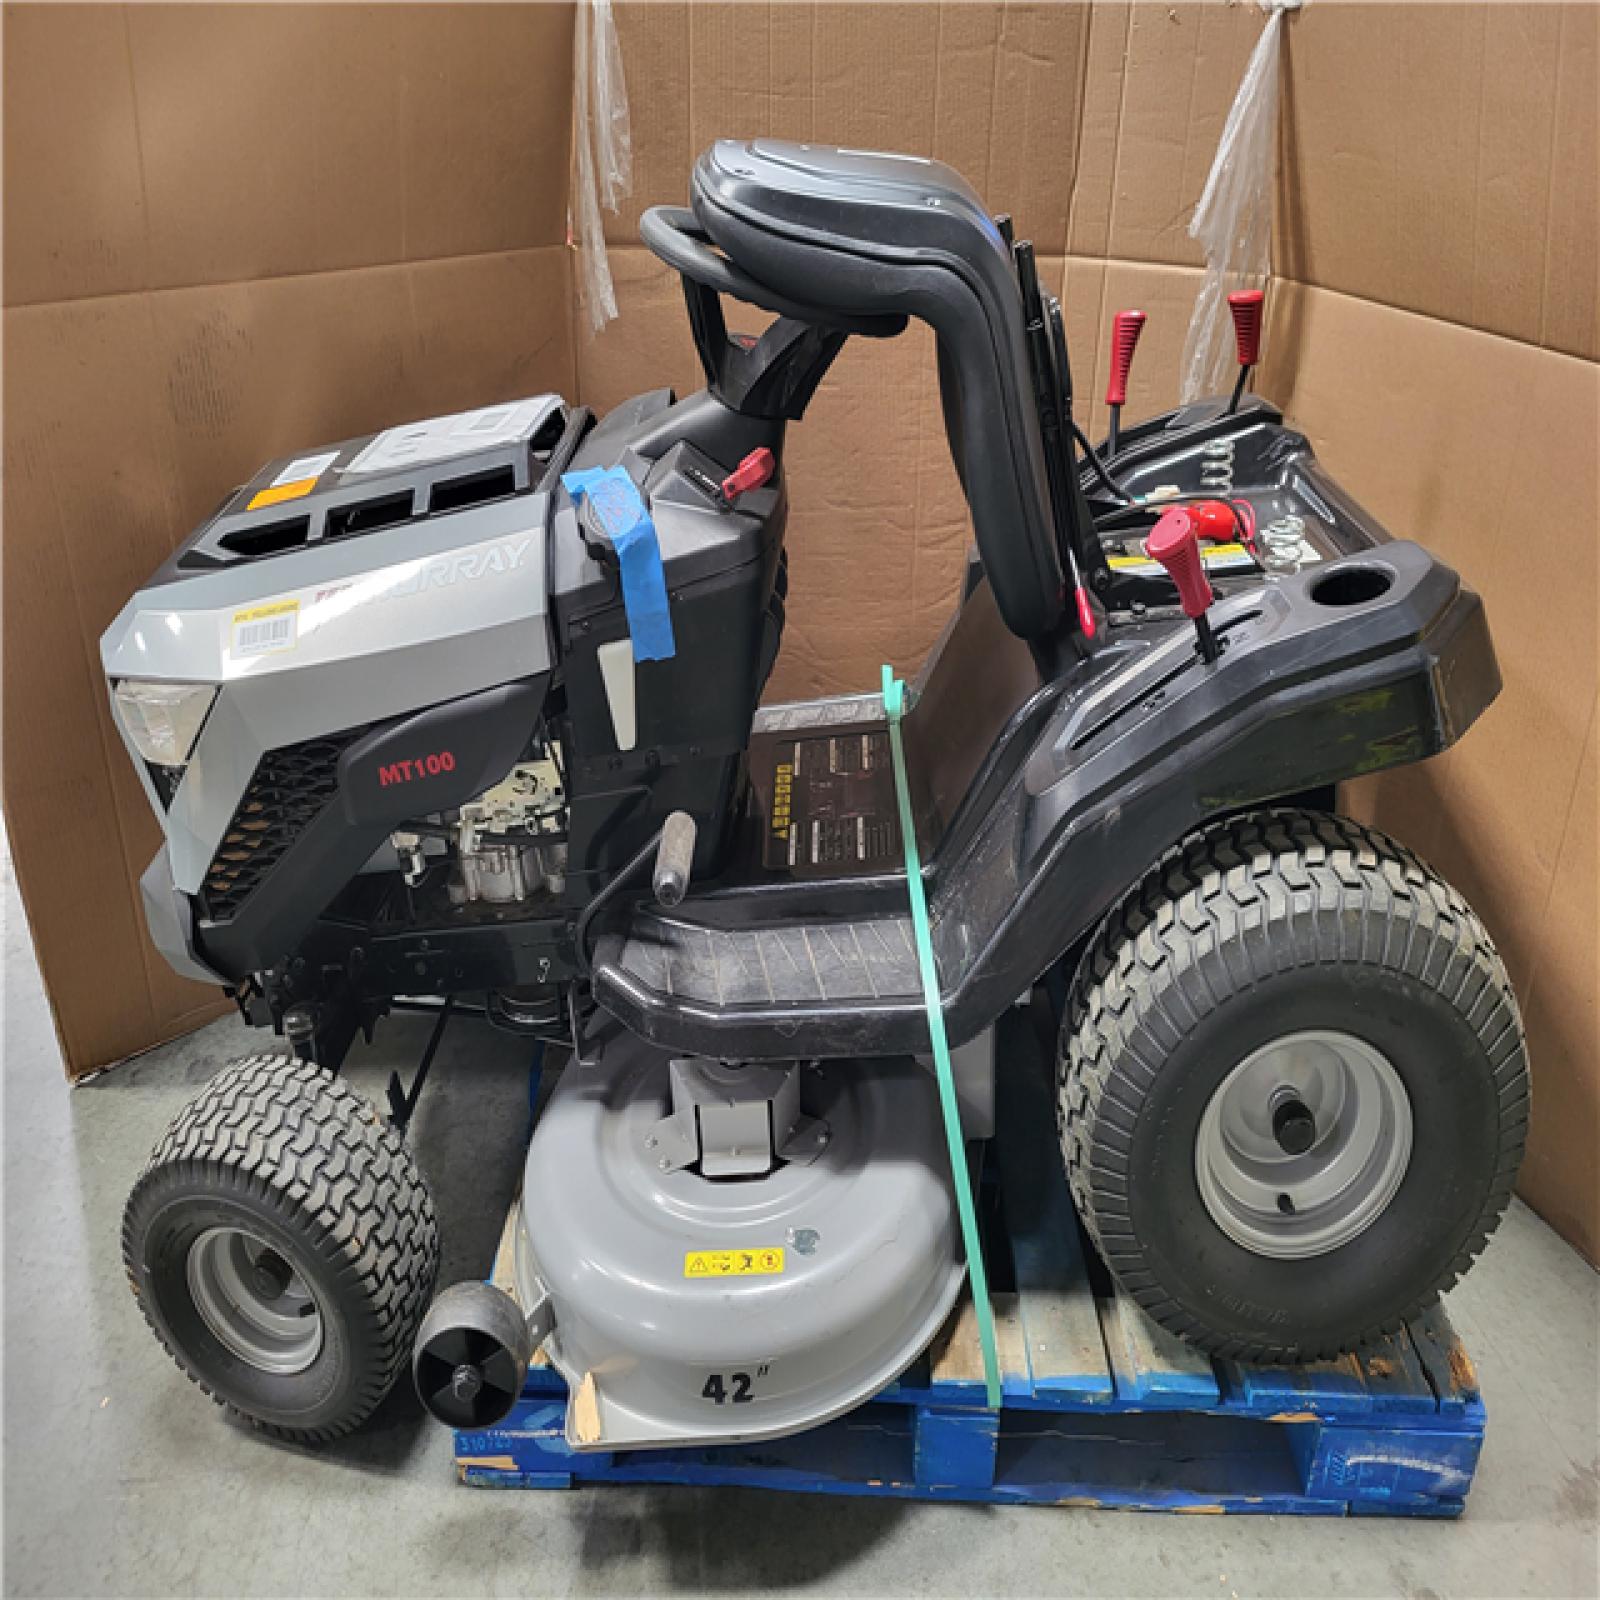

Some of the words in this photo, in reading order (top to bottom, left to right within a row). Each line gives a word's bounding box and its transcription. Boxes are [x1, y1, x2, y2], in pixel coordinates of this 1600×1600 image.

[372, 538, 531, 601] URRAY
[379, 751, 456, 787] MT100
[702, 1364, 770, 1405] 42"
